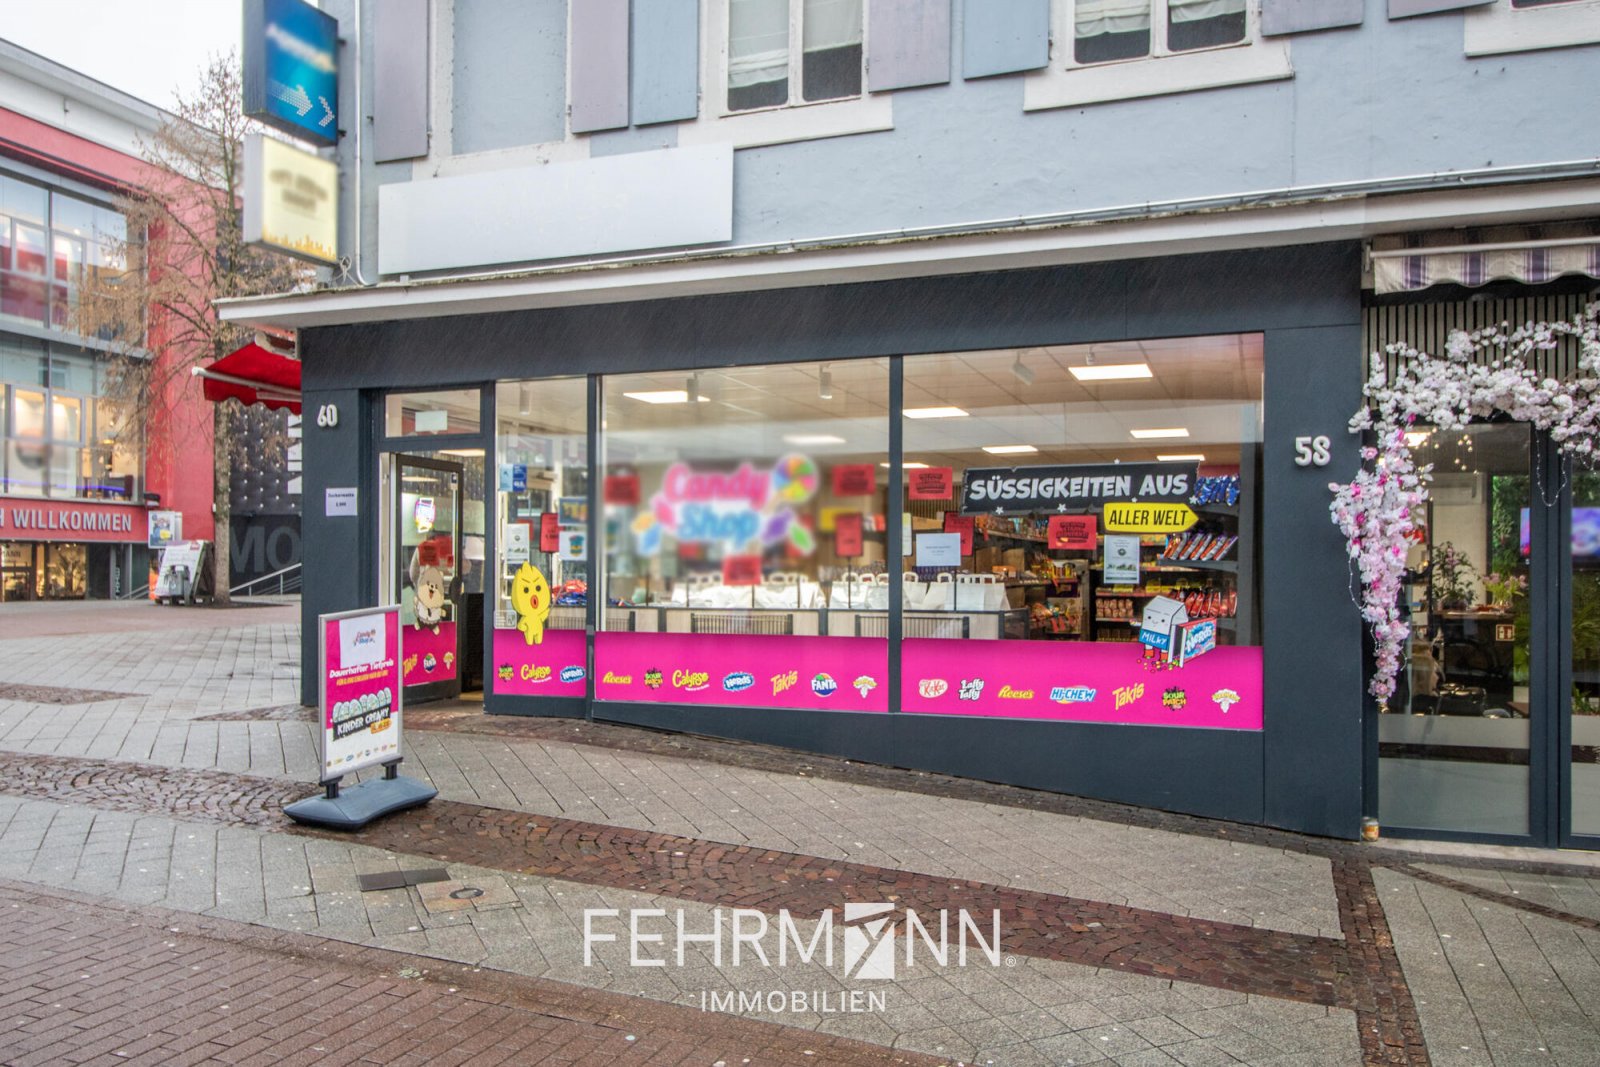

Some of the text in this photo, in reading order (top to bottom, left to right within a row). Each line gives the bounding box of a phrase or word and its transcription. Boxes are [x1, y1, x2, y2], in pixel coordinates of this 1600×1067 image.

[317, 404, 338, 427] 60
[1294, 435, 1331, 467] 58
[969, 475, 1131, 501] SÜSSIGKEITEN
[1139, 473, 1189, 497] AUS
[12, 508, 132, 532] WILLKOMMEN
[1109, 509, 1189, 526] ALLER WELT
[770, 670, 798, 696] Takis
[1112, 683, 1145, 711] Takis
[337, 717, 364, 735] KINDER
